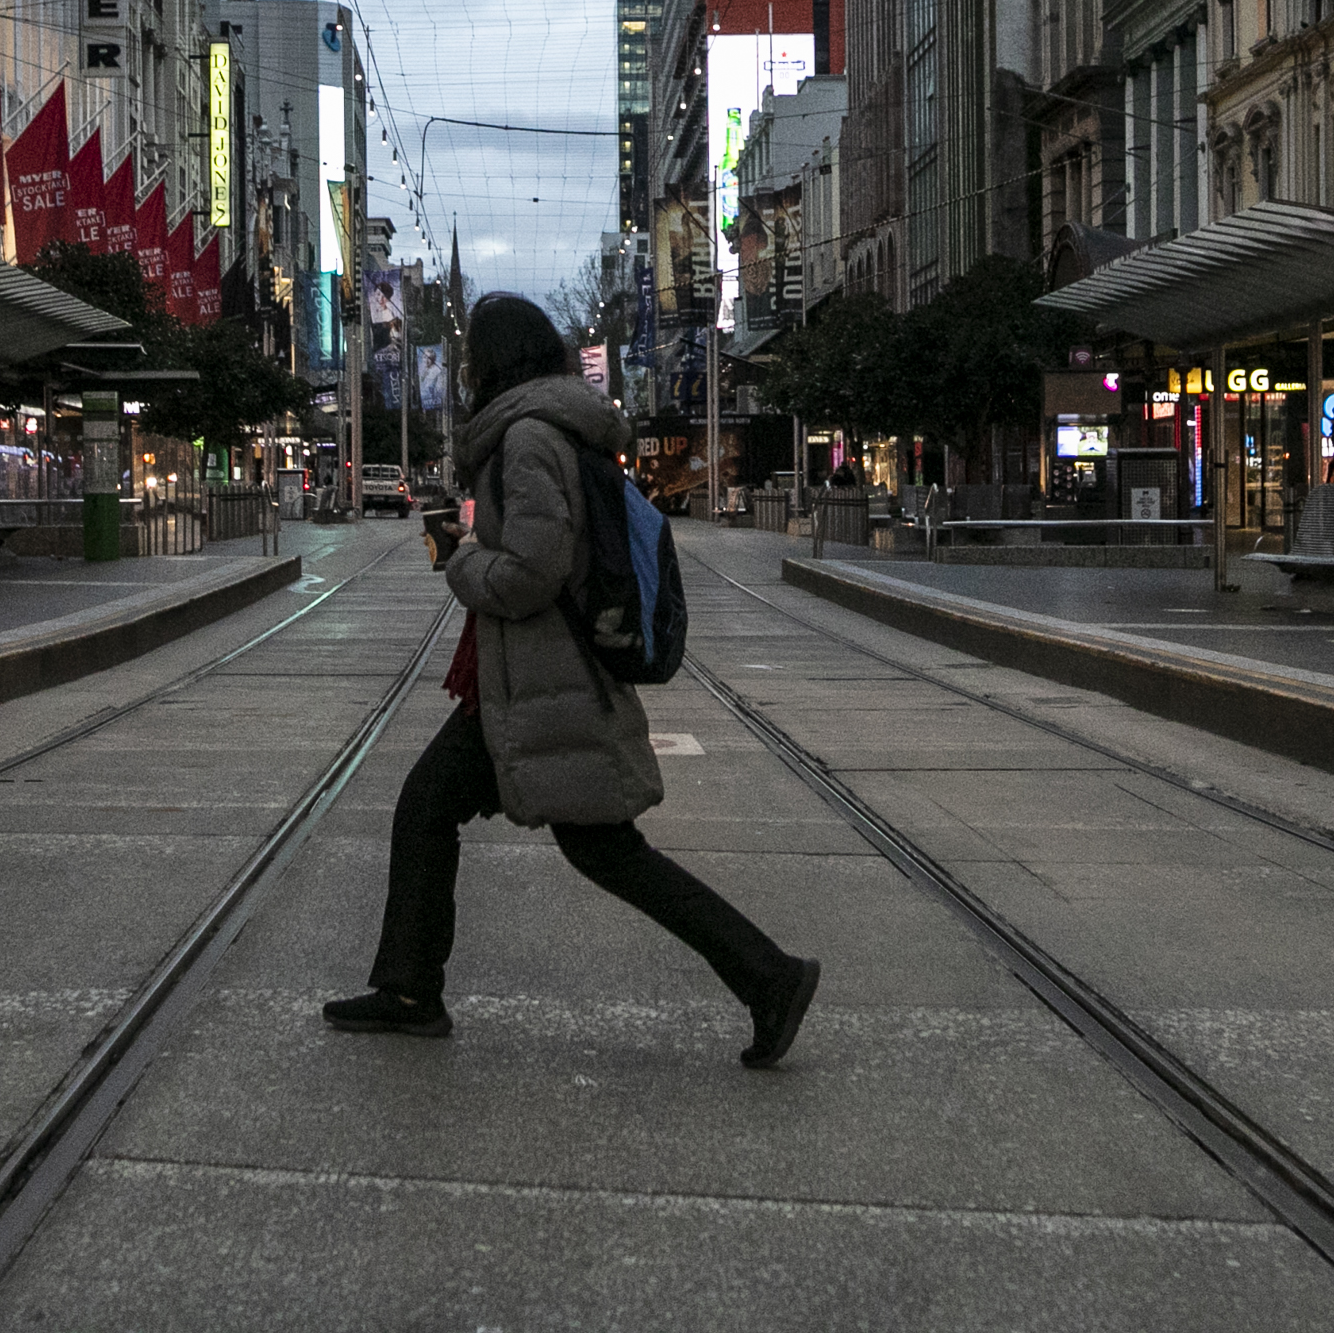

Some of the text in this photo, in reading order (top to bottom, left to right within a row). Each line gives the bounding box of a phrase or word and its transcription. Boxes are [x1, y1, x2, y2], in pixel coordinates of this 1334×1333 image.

[214, 53, 227, 221] DAVID JONES
[19, 170, 63, 184] MYER
[17, 179, 67, 197] STOCKTAKE
[22, 191, 66, 211] SALE
[636, 436, 687, 456] RED UP
[364, 483, 393, 491] TOYOTA
